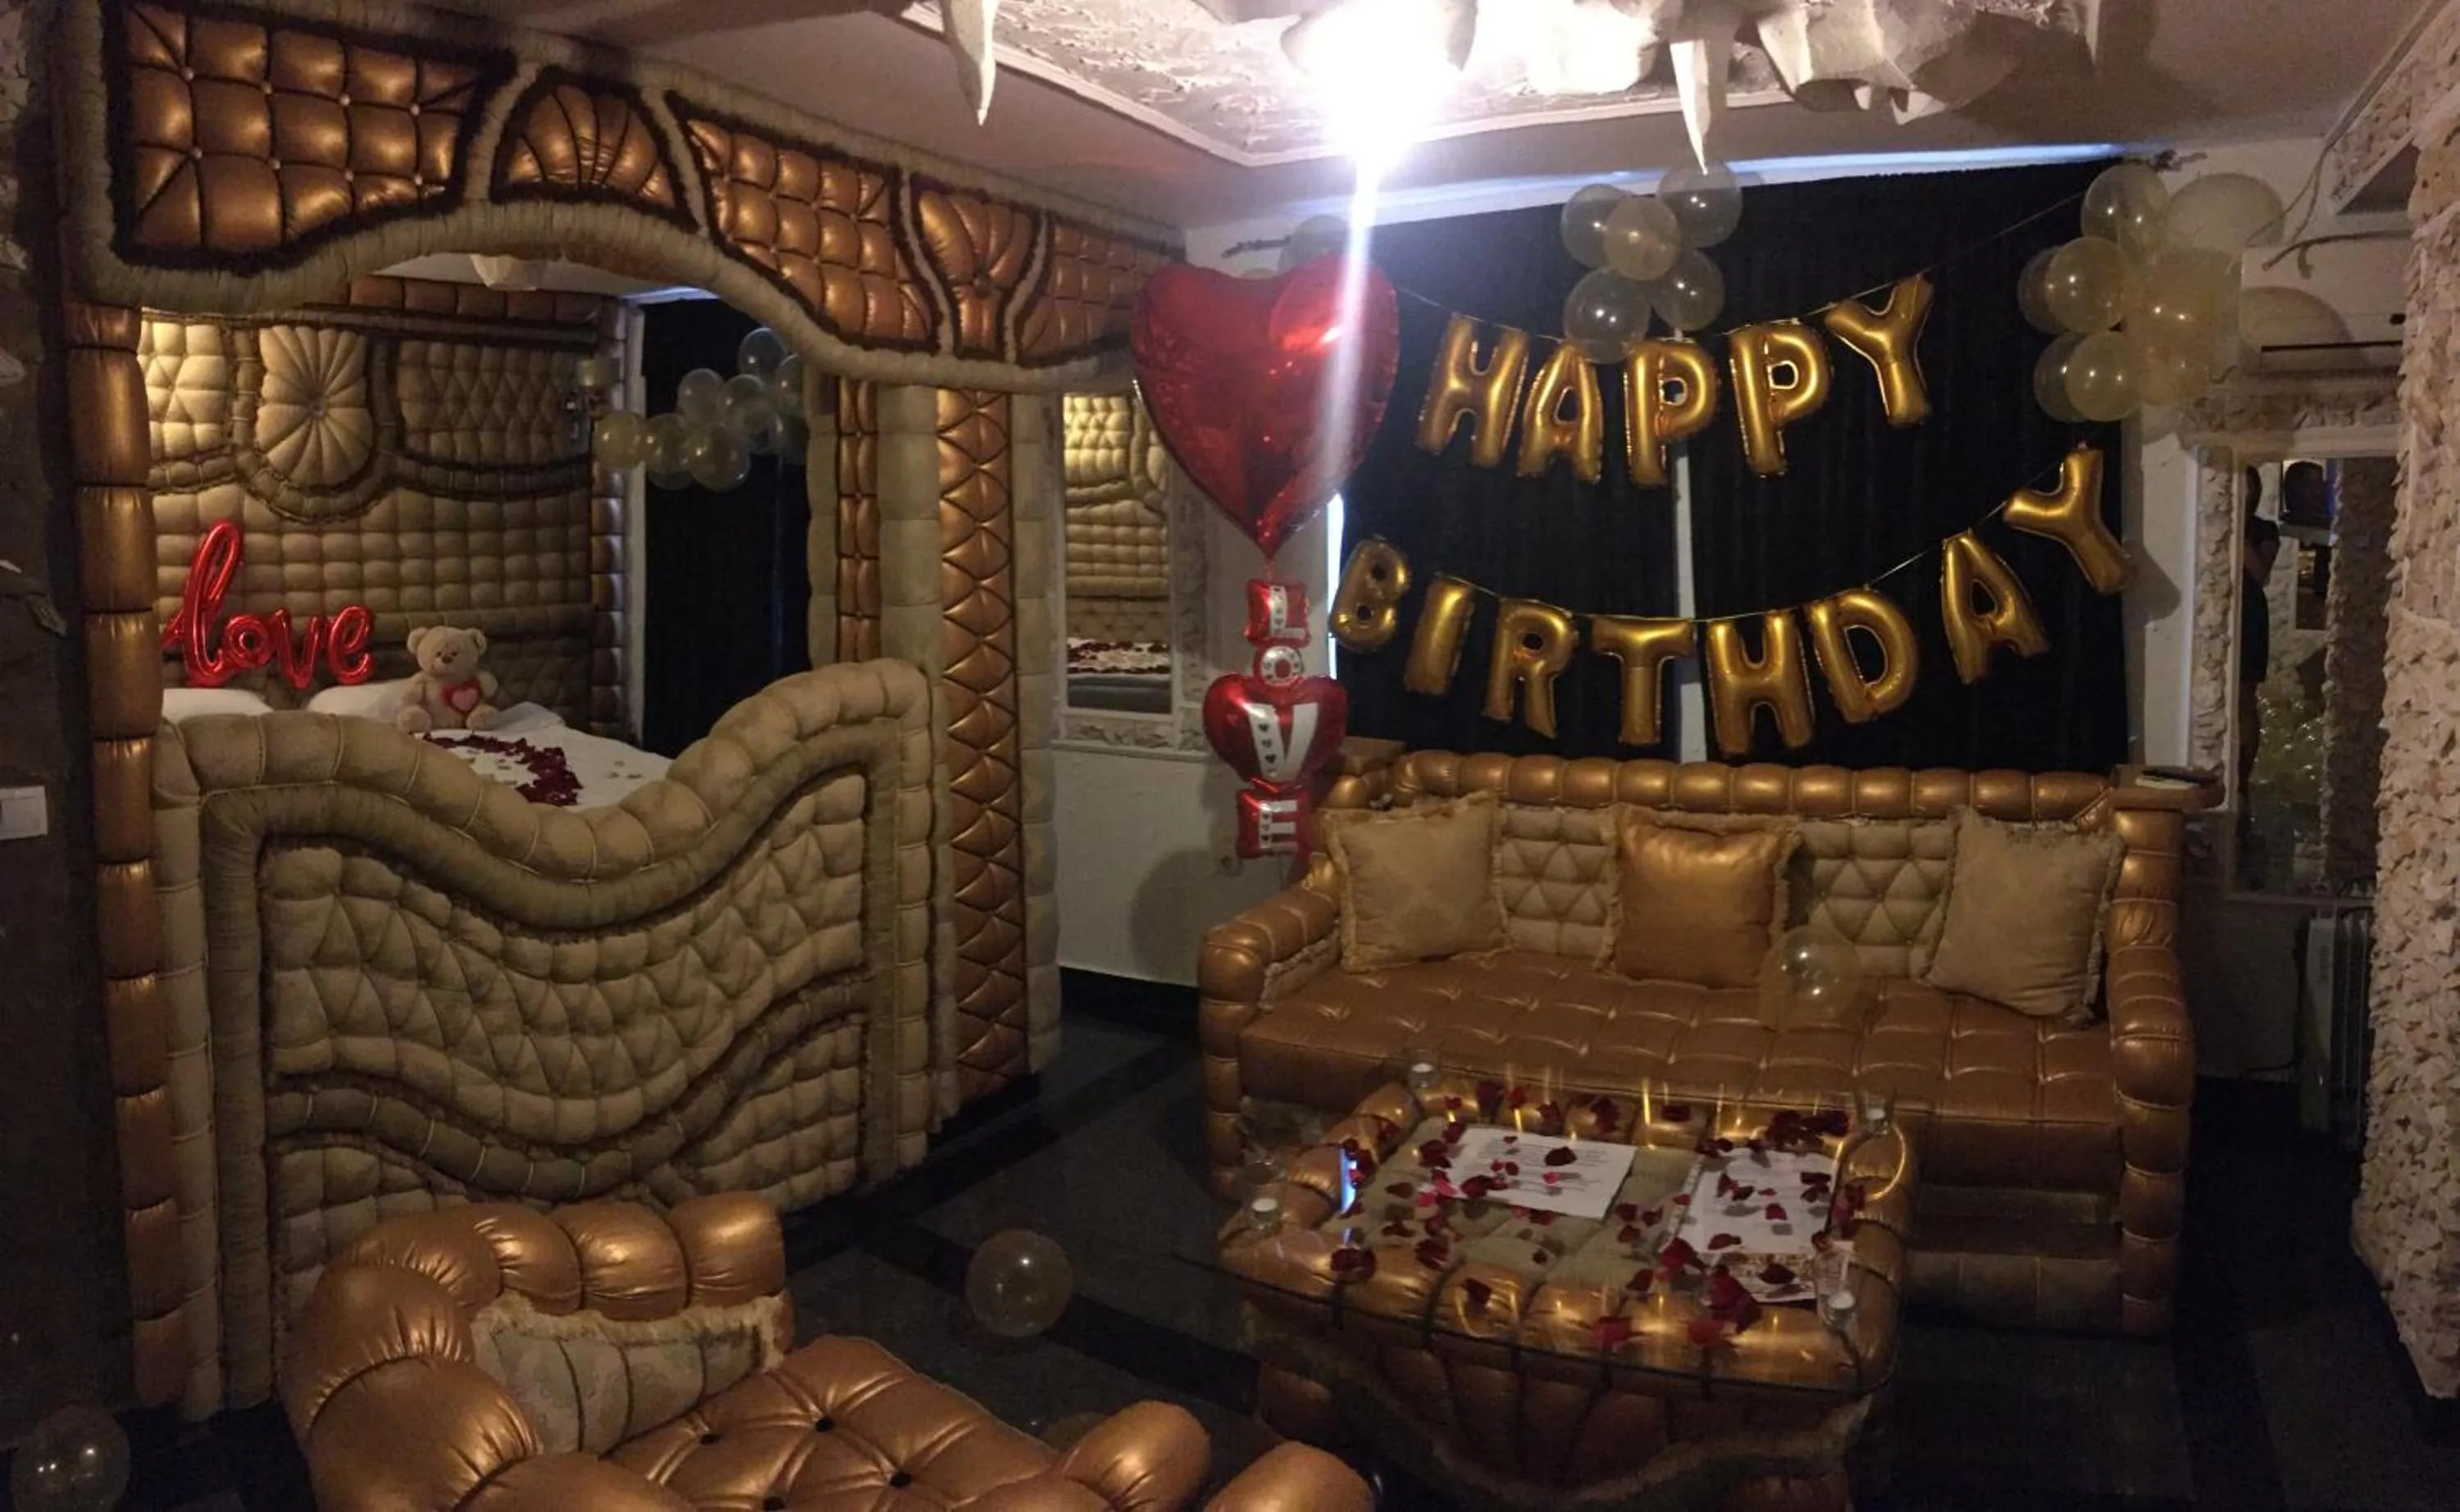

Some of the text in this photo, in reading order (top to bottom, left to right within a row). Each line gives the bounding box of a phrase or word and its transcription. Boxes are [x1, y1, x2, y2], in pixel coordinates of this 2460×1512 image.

[1415, 273, 1934, 487] HAPPY
[160, 520, 376, 689] love
[1246, 585, 1319, 850] LOVE
[1328, 444, 2134, 758] BIRTHDAY
